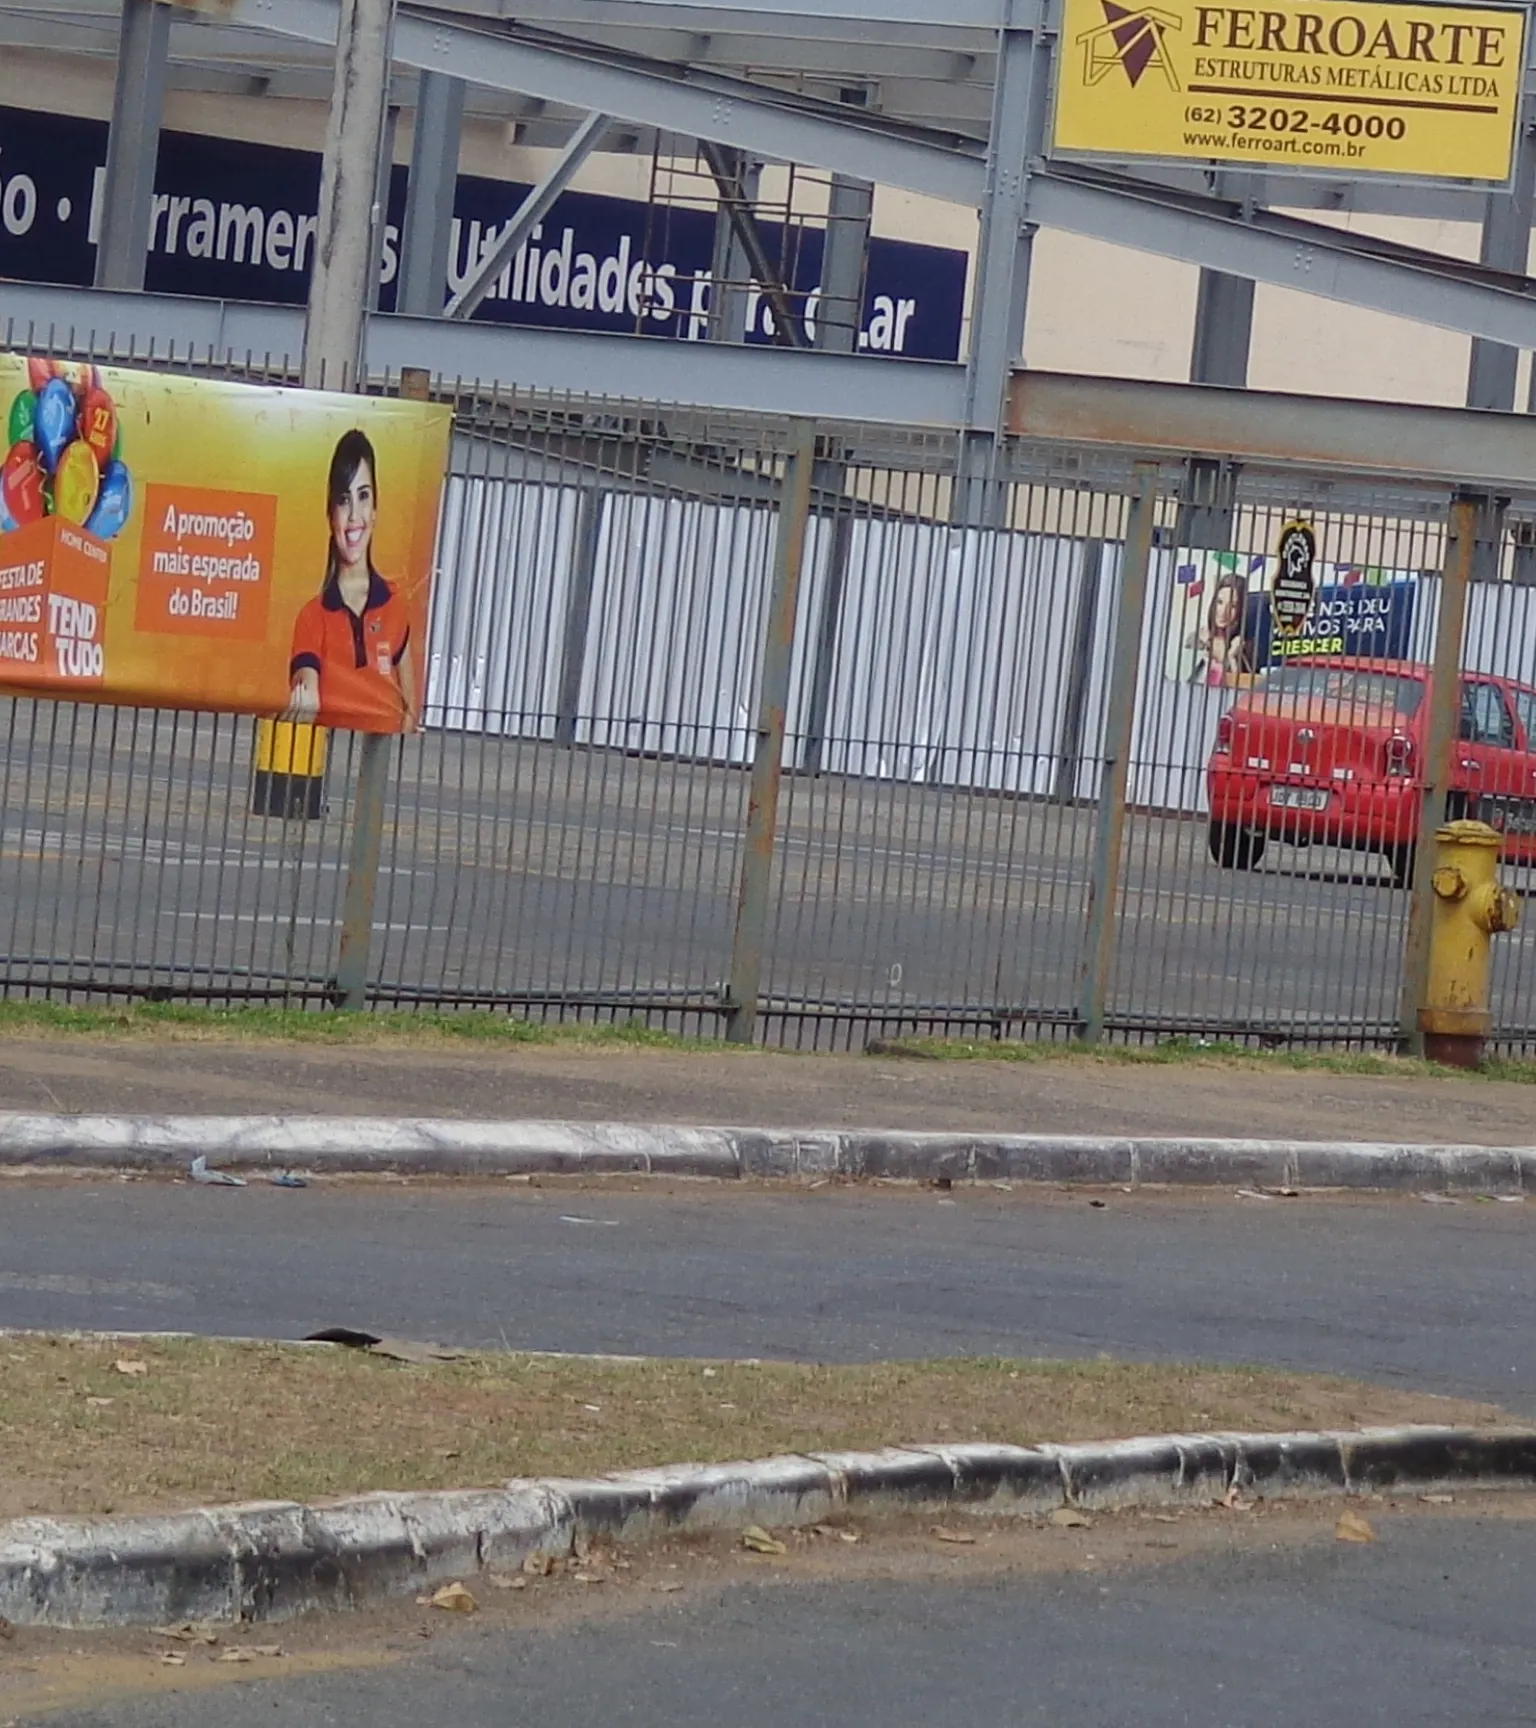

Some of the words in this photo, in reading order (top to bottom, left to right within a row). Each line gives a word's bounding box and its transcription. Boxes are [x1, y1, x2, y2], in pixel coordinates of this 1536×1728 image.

[1192, 5, 1507, 68] FERROARTE
[1194, 57, 1322, 86] ESTRUTURAS
[1325, 64, 1444, 94] METÁLICAS
[1447, 75, 1500, 98] LTDA
[1184, 105, 1223, 126] (62)
[1227, 105, 1407, 140] 3202-4000
[1182, 132, 1367, 159] www.ferroart.com.br
[163, 503, 176, 533] A
[176, 511, 254, 548] promoção
[26, 560, 45, 586] DE
[153, 546, 190, 575] mais
[192, 552, 261, 585] esperada
[48, 592, 97, 640] TEND
[168, 587, 190, 615] do
[191, 588, 239, 620] Brasil!
[55, 637, 104, 677] TUDO
